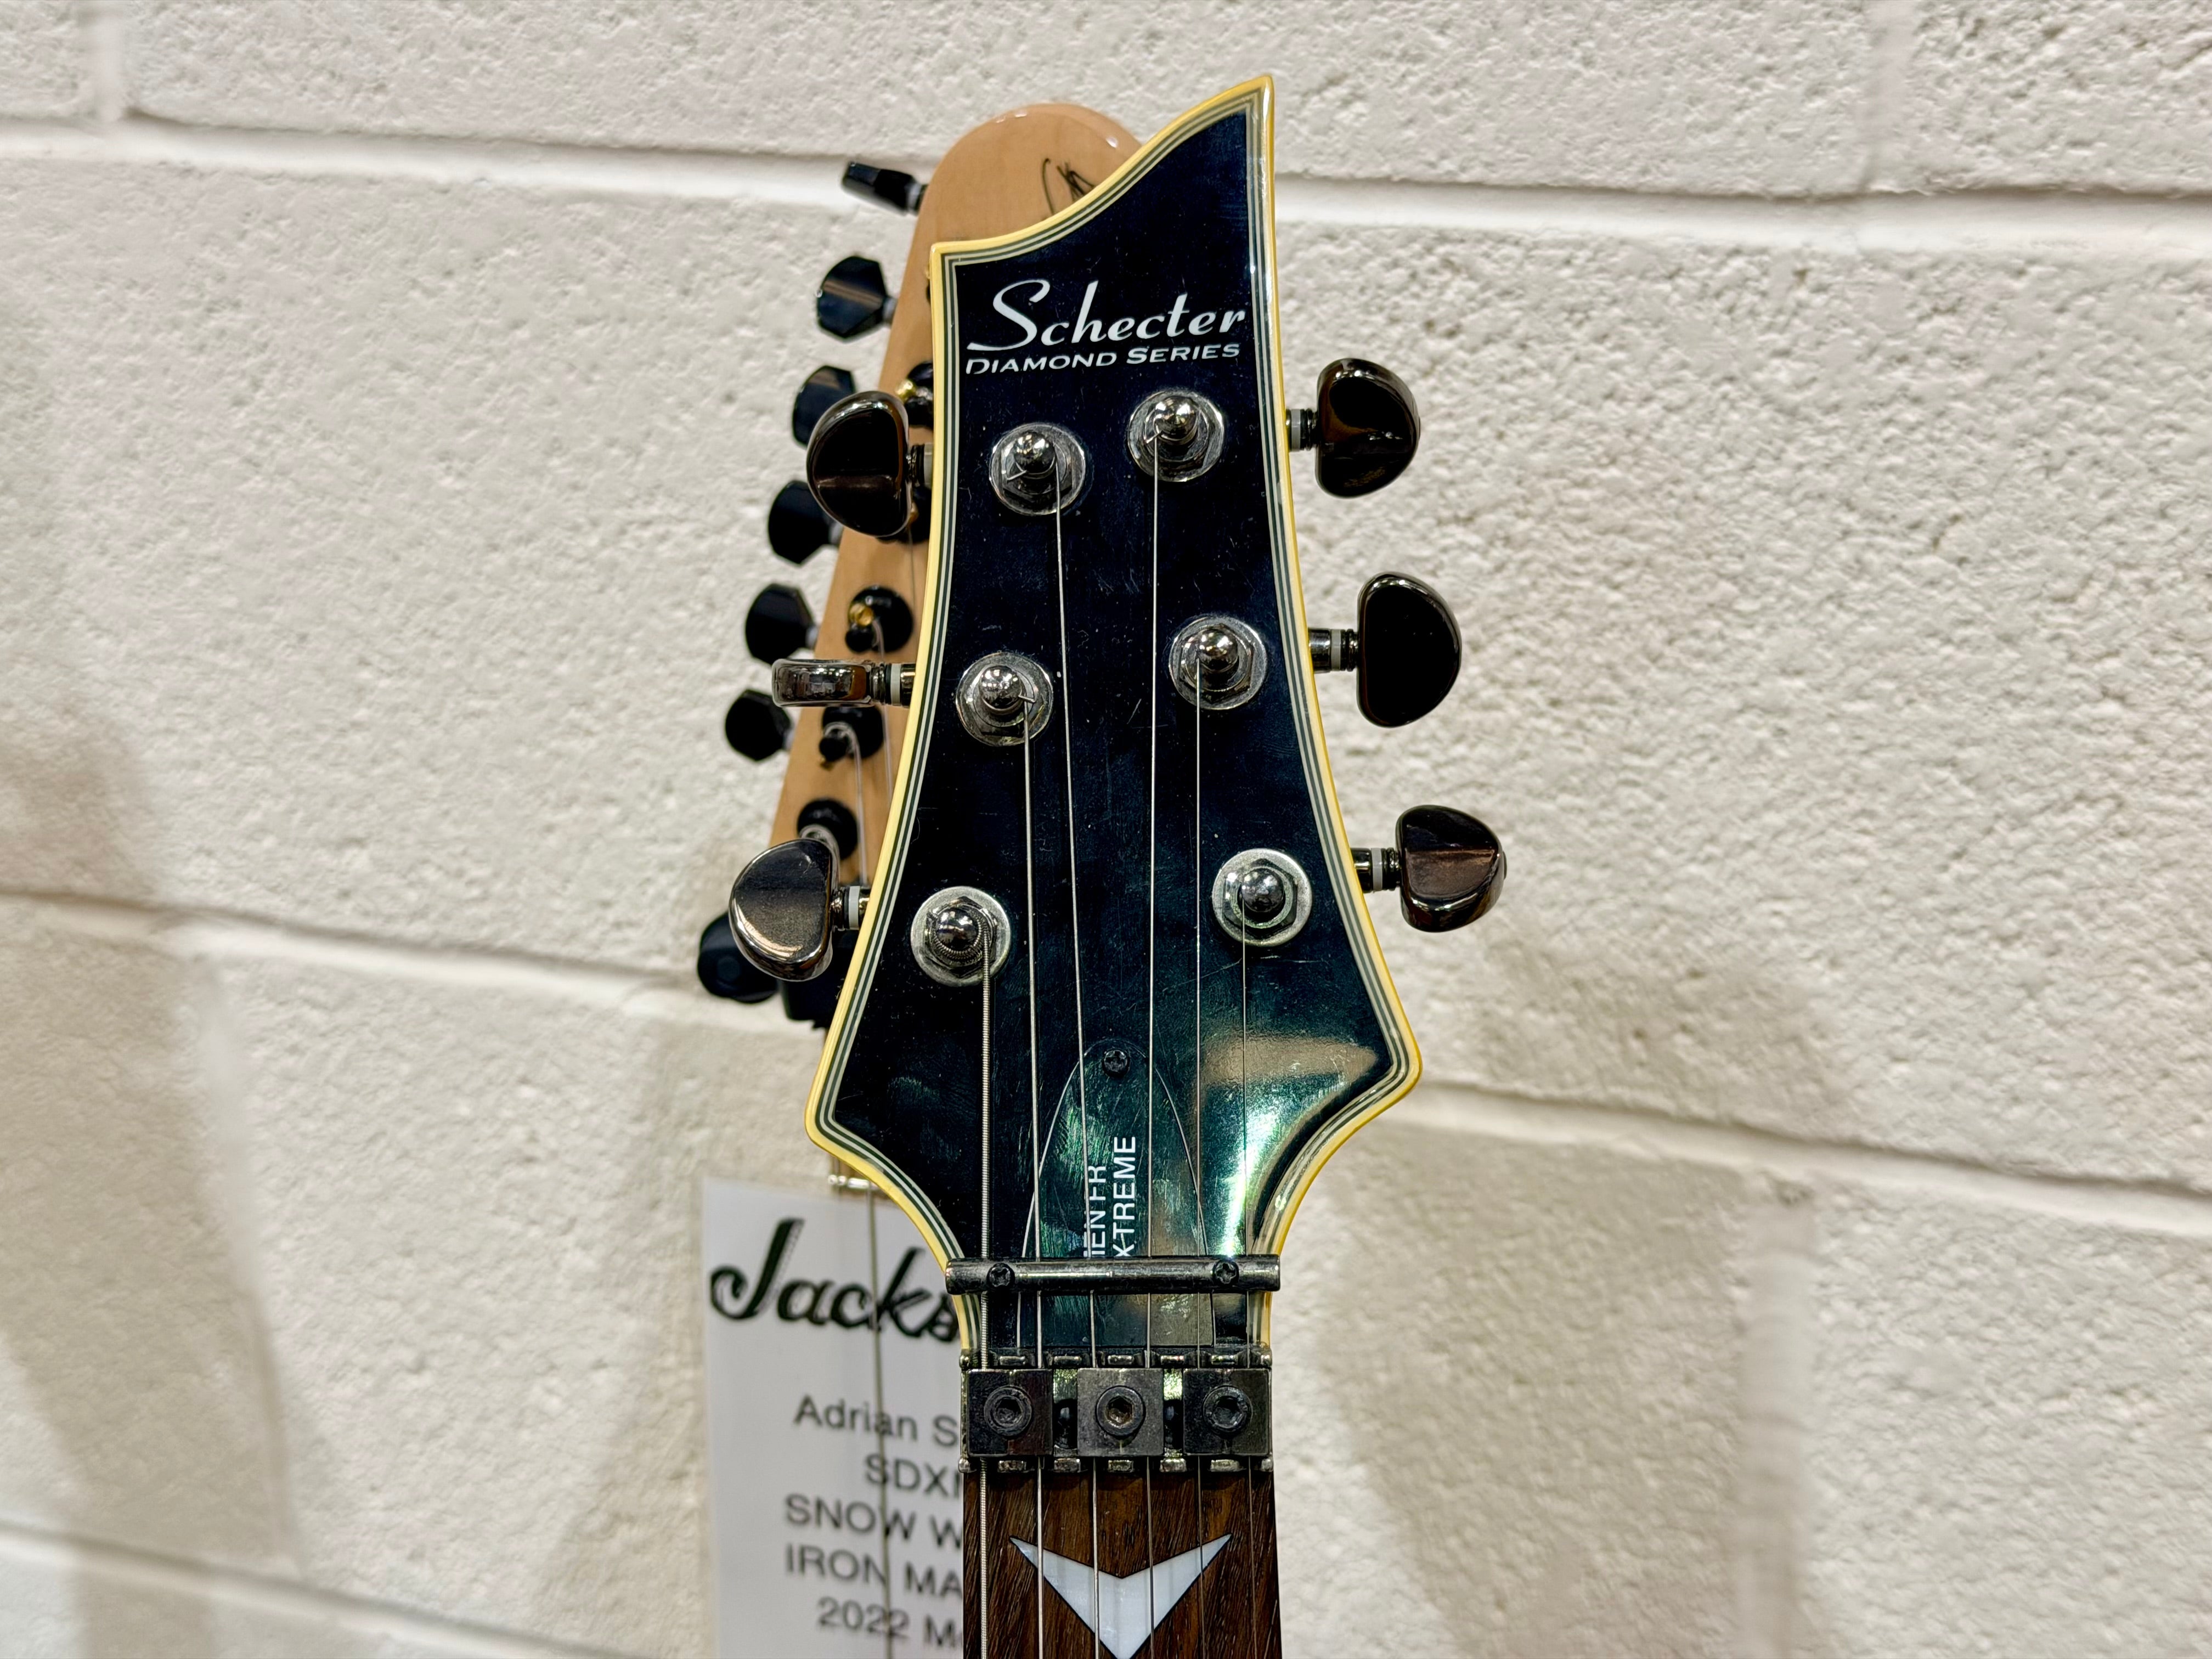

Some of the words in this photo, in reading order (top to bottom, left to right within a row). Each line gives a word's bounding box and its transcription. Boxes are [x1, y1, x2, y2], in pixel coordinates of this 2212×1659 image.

[967, 279, 1245, 351] Schecter
[966, 352, 1117, 375] DIAMOND
[1126, 343, 1240, 364] SERIES
[794, 1395, 917, 1442] Adrian
[786, 1493, 917, 1542] SNOW
[787, 1542, 889, 1588] IRON
[818, 1595, 910, 1640] 2022
